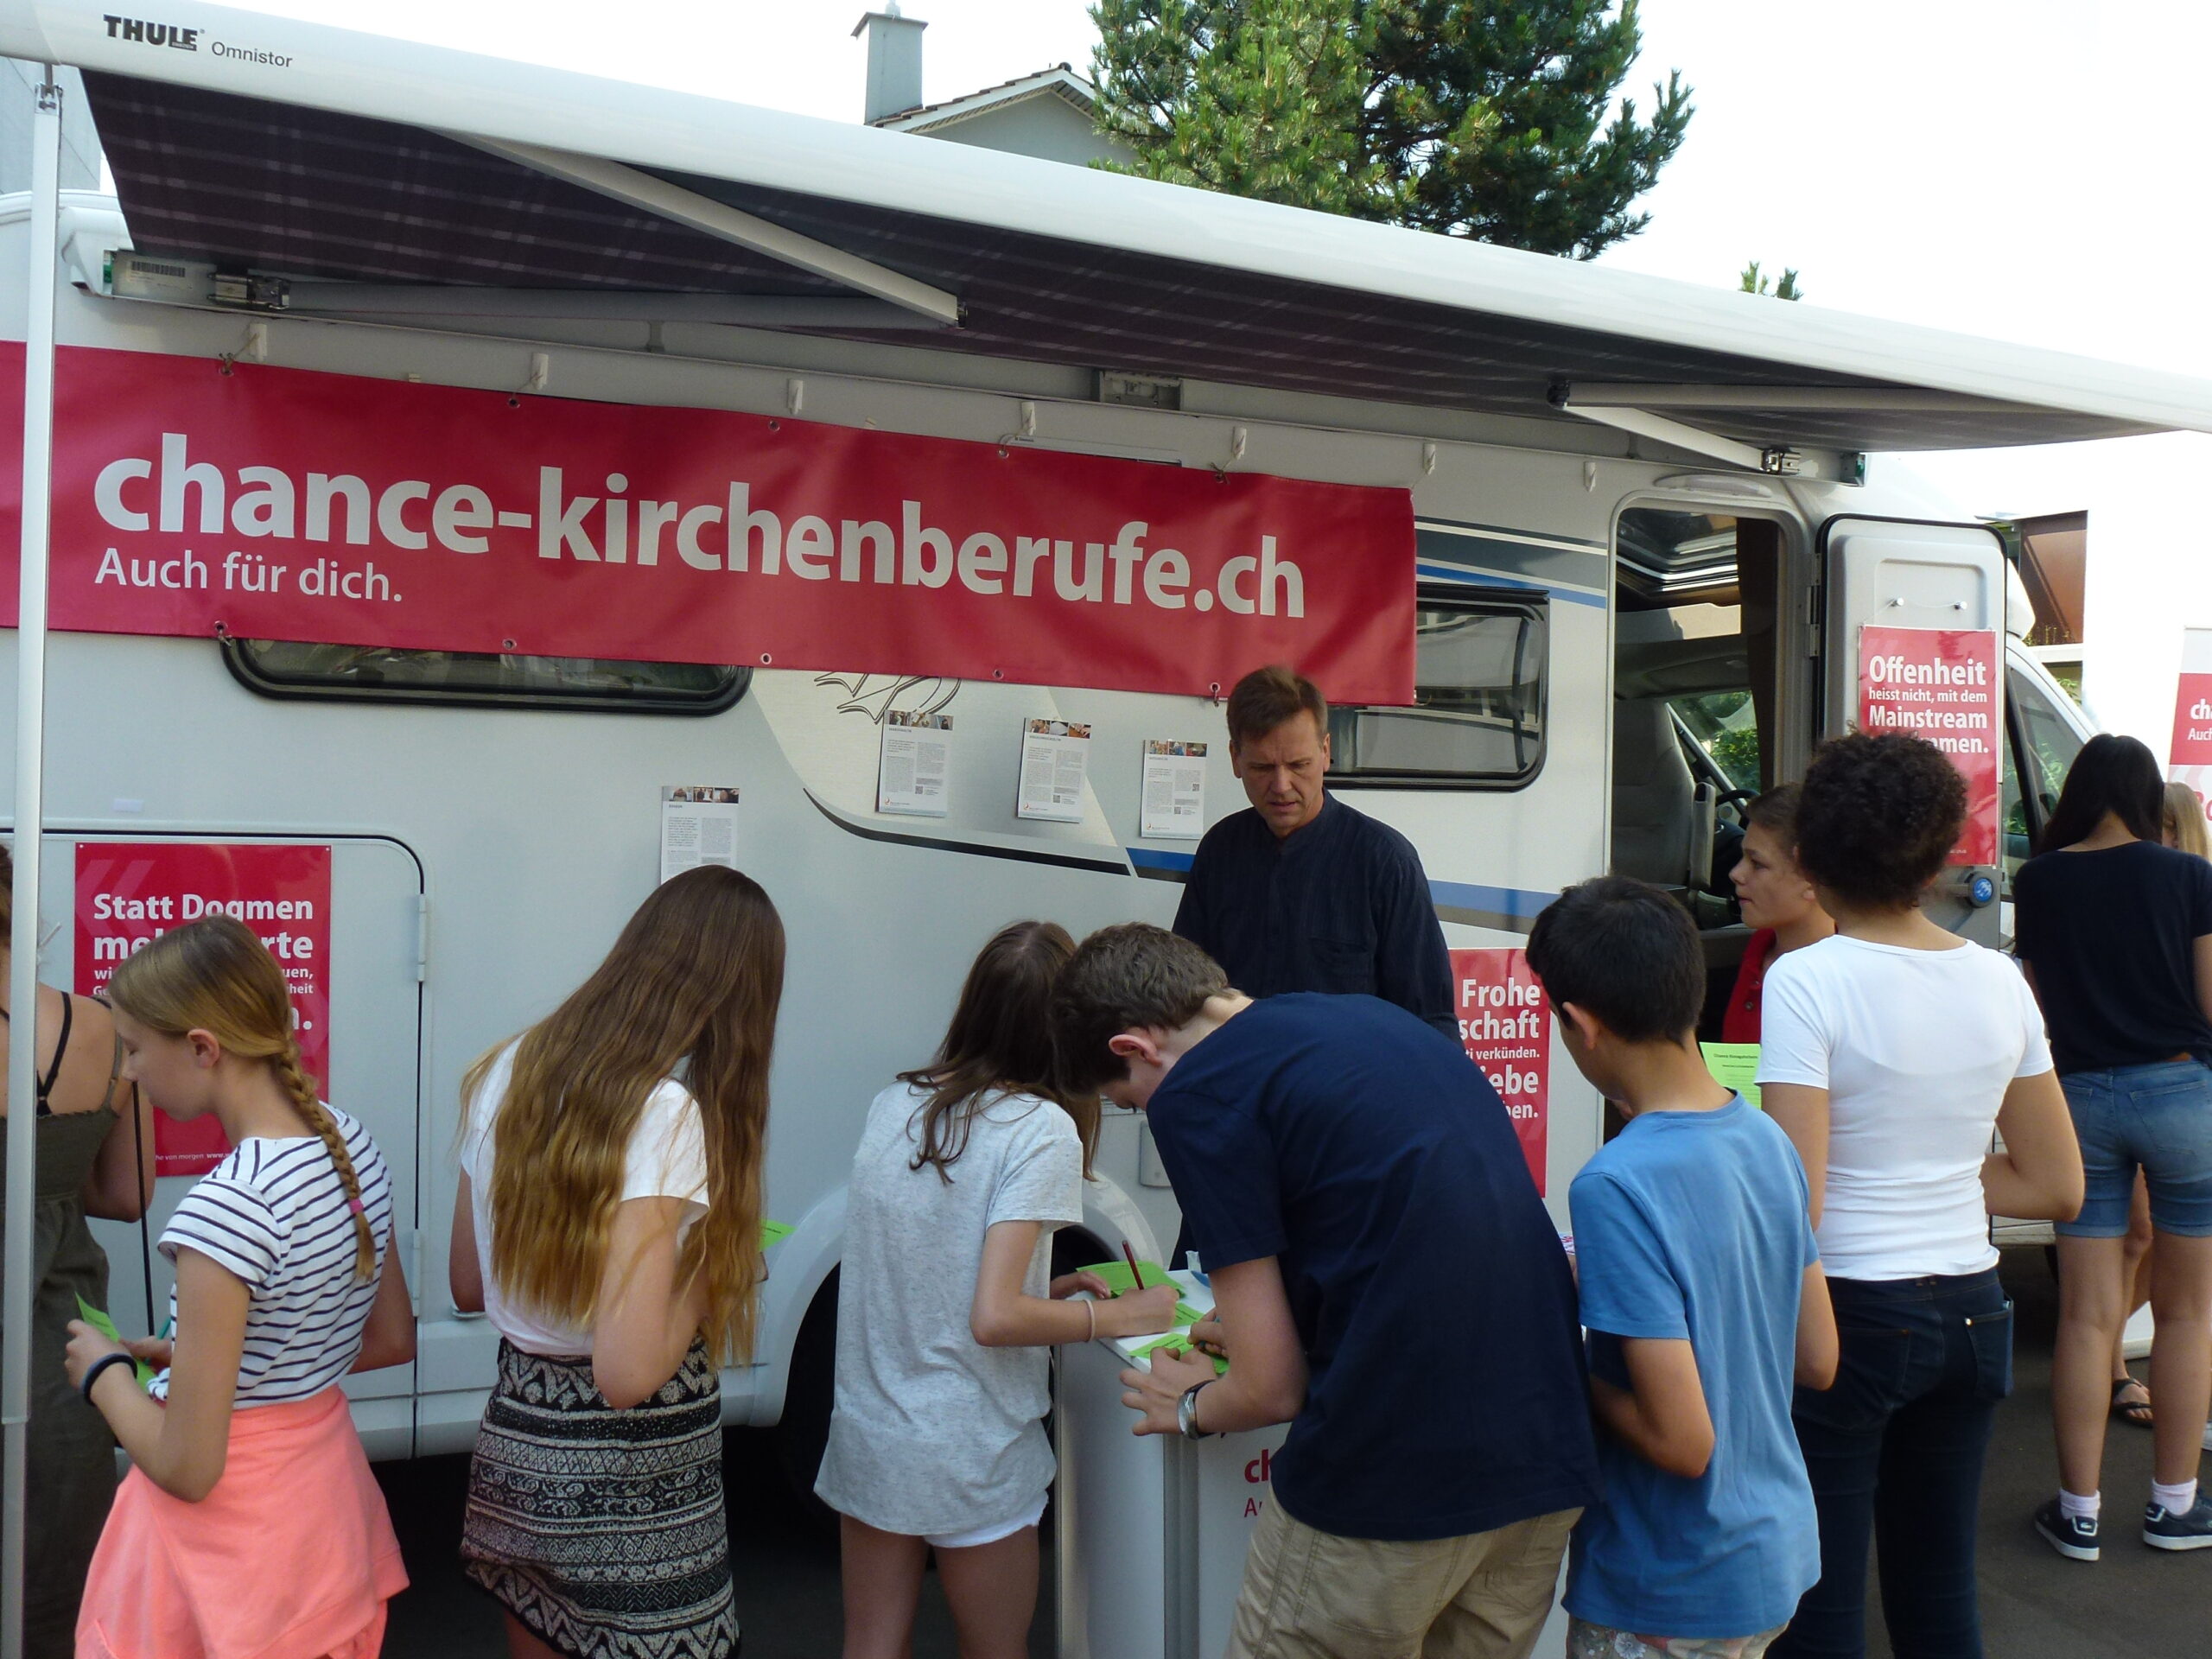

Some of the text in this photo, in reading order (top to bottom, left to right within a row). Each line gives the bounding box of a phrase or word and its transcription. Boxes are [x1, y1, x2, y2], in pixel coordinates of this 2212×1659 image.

[103, 14, 293, 67] THULE Omnistor
[92, 432, 1306, 620] chance-kirchenberufe.ch
[94, 547, 404, 603] Auch für dich.
[1869, 655, 1986, 685] Offenheit
[1869, 687, 1987, 703] heisst nicht, mit dem
[1869, 705, 1987, 728] Mainstream
[93, 893, 314, 921] Statt Dogmen
[1462, 977, 1541, 1007] Frohe
[1459, 1009, 1540, 1040] schaft
[1476, 1046, 1540, 1060] verkünden.
[1480, 1065, 1539, 1095] ebe
